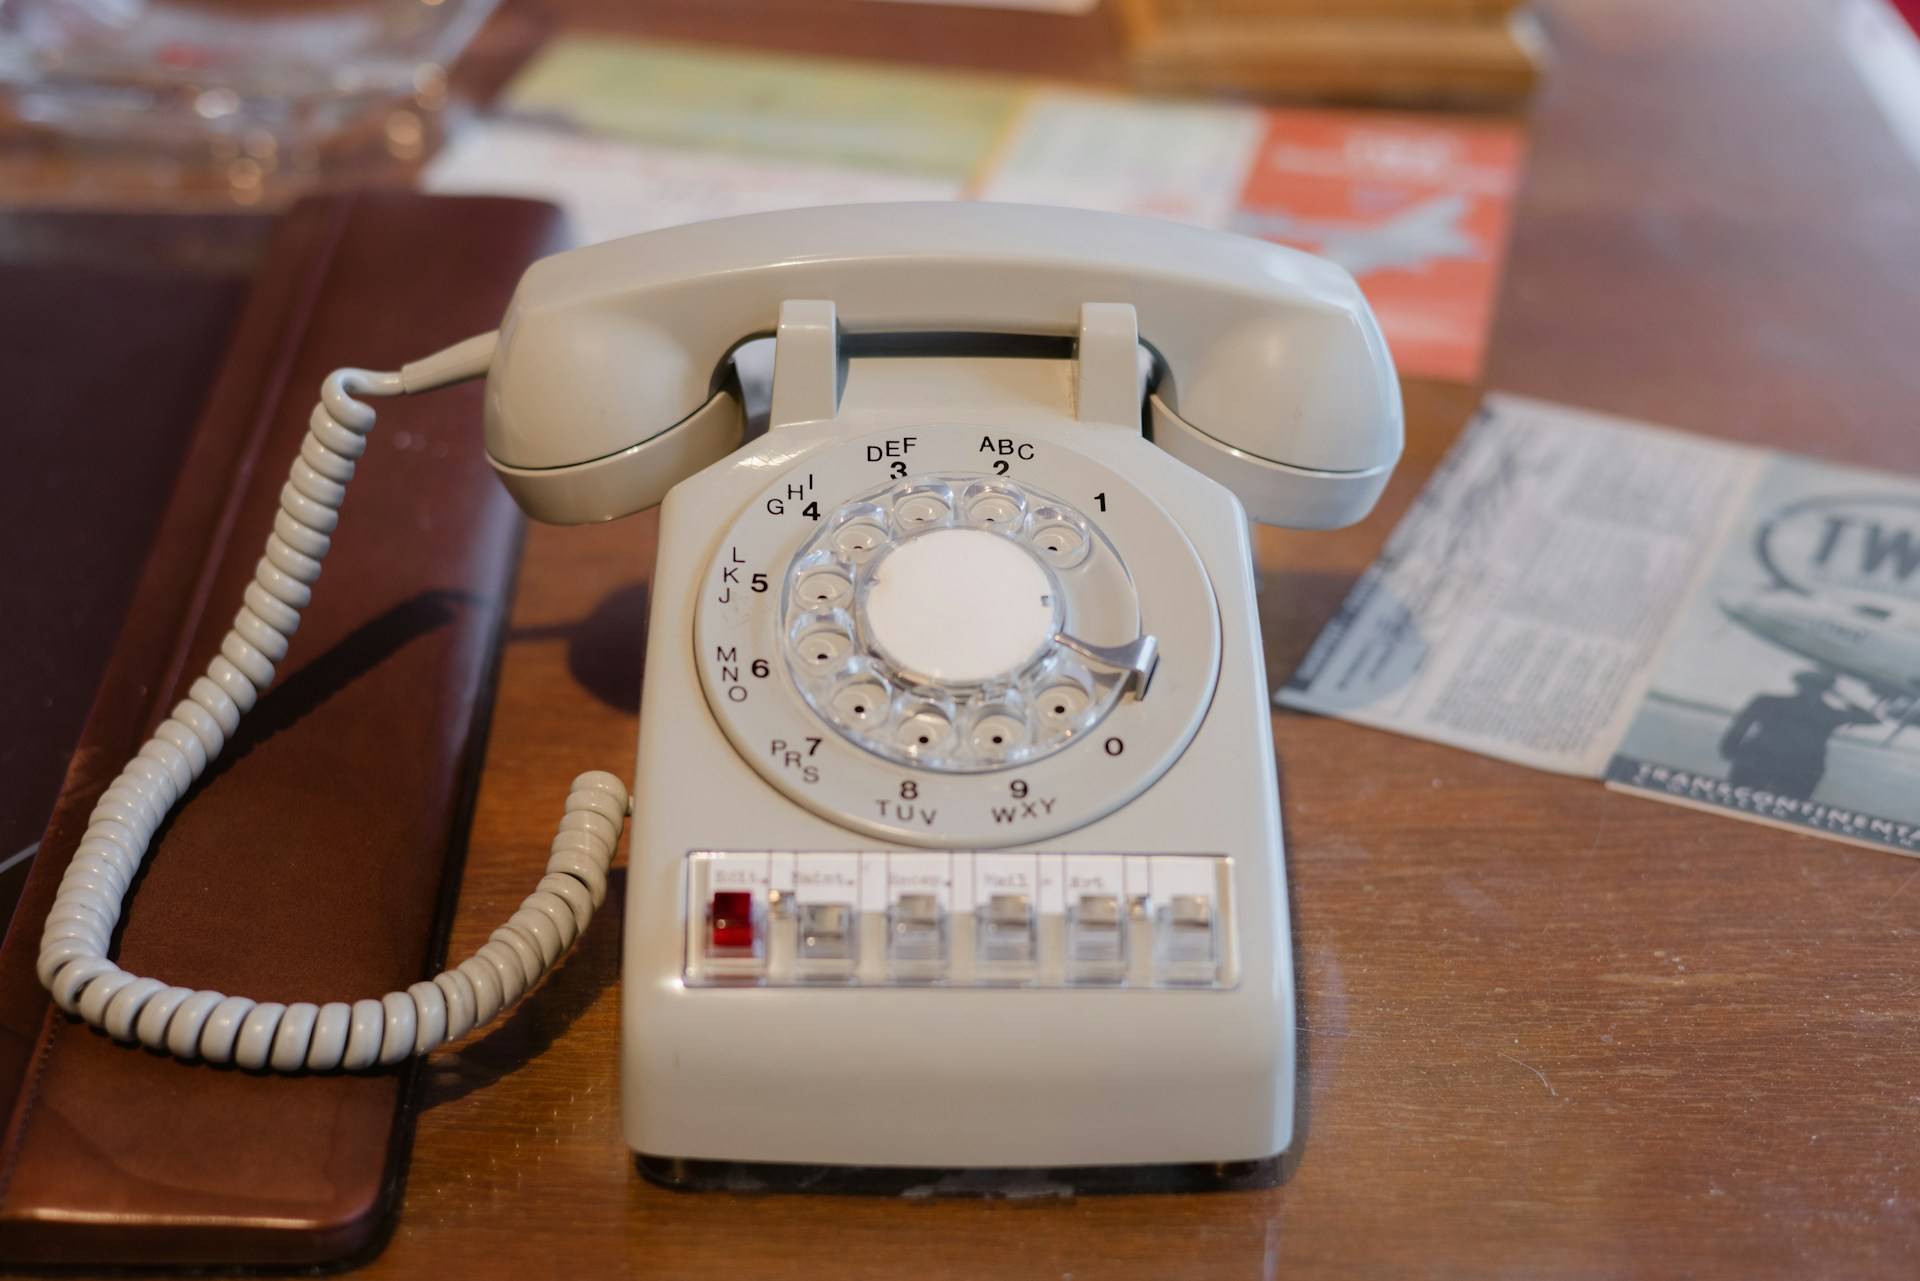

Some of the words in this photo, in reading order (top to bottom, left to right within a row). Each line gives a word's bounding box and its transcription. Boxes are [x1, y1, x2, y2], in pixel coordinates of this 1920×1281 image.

[866, 437, 918, 462] DEF
[979, 436, 1035, 461] ABC
[890, 461, 908, 480] 3
[993, 460, 1010, 478] 2
[766, 473, 813, 516] GHI
[1094, 493, 1107, 512] 1
[802, 501, 821, 521] 4
[751, 573, 769, 592] 5
[717, 646, 748, 703] MNO
[751, 658, 770, 678] 6
[805, 737, 823, 756] 7
[771, 739, 820, 784] PRS
[900, 780, 918, 800] 8
[1010, 779, 1028, 799] 9
[876, 799, 937, 826] TUV
[991, 797, 1056, 824] WXY
